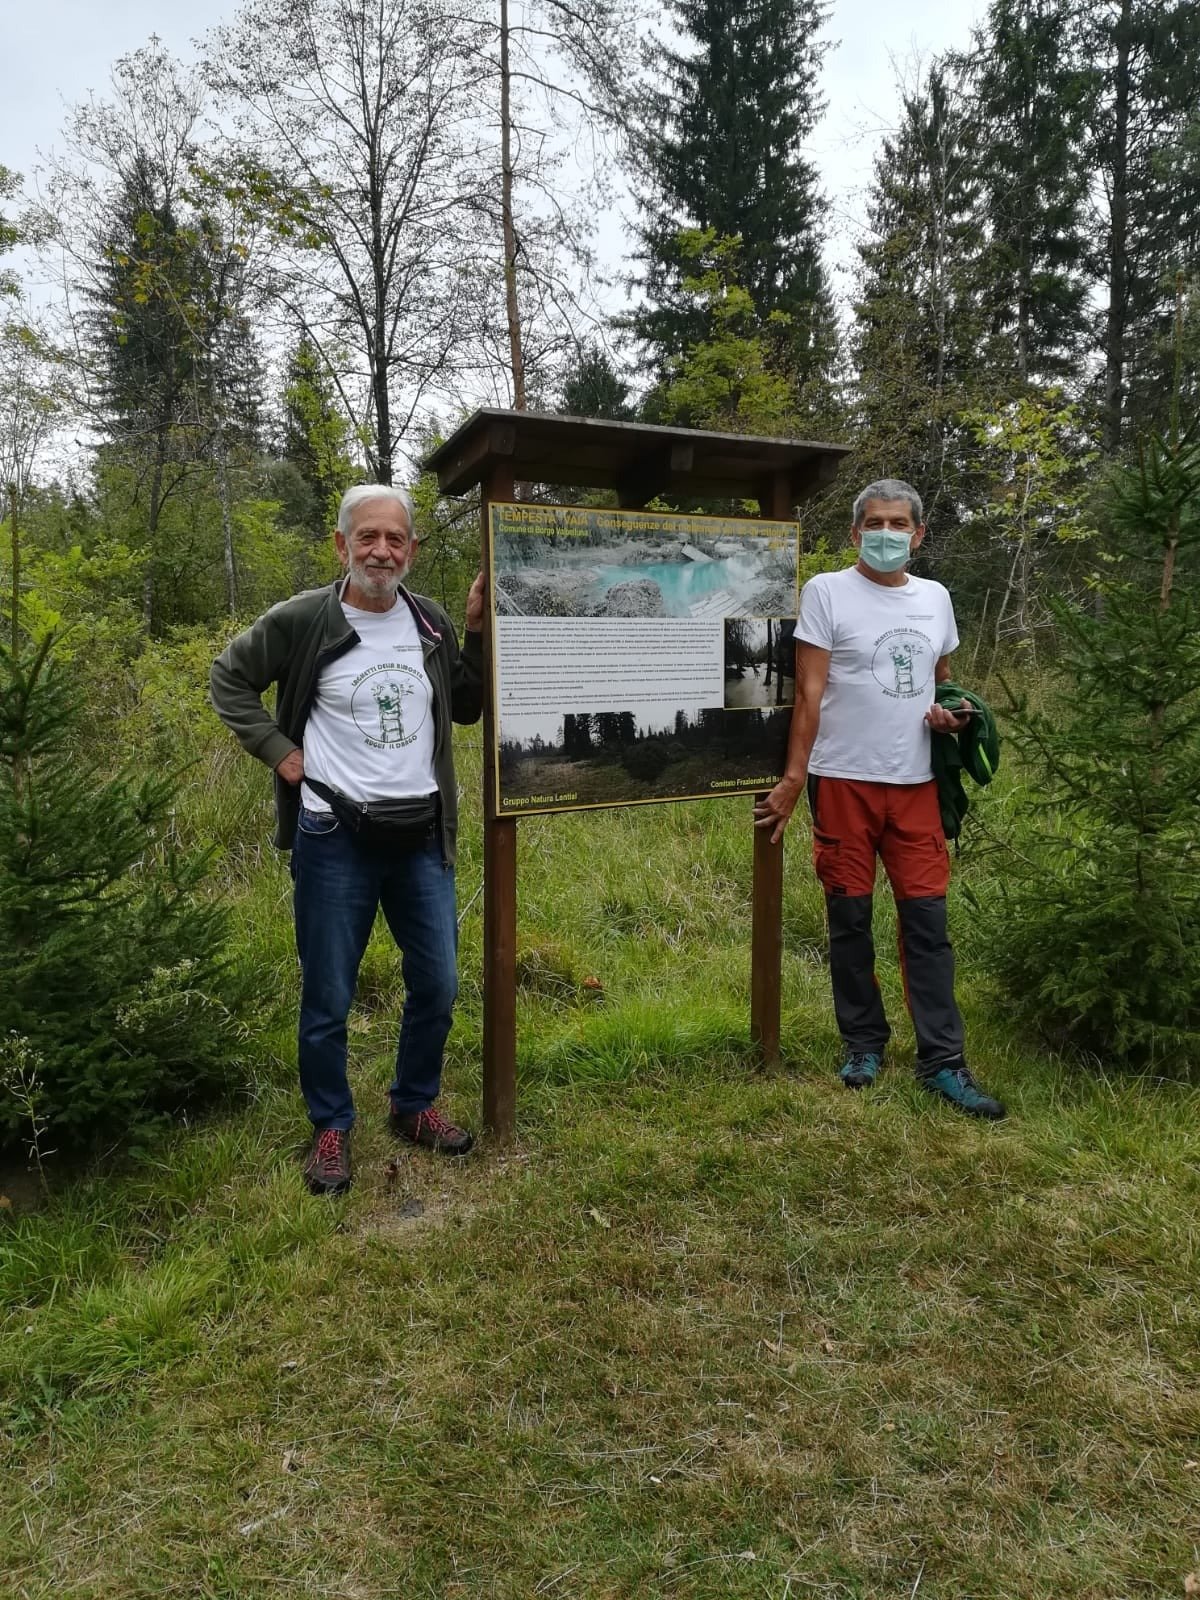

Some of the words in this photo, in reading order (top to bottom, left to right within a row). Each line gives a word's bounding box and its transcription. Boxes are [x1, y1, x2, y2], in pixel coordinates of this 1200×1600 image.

[498, 510, 557, 524] TEMPESTA
[597, 517, 660, 531] Conseguenze
[498, 523, 527, 533] Comune
[535, 527, 555, 536] Borgo
[710, 780, 736, 788] Comitato
[736, 777, 765, 786] Frazionale
[503, 797, 530, 806] Gruppo
[530, 794, 554, 803] Natura
